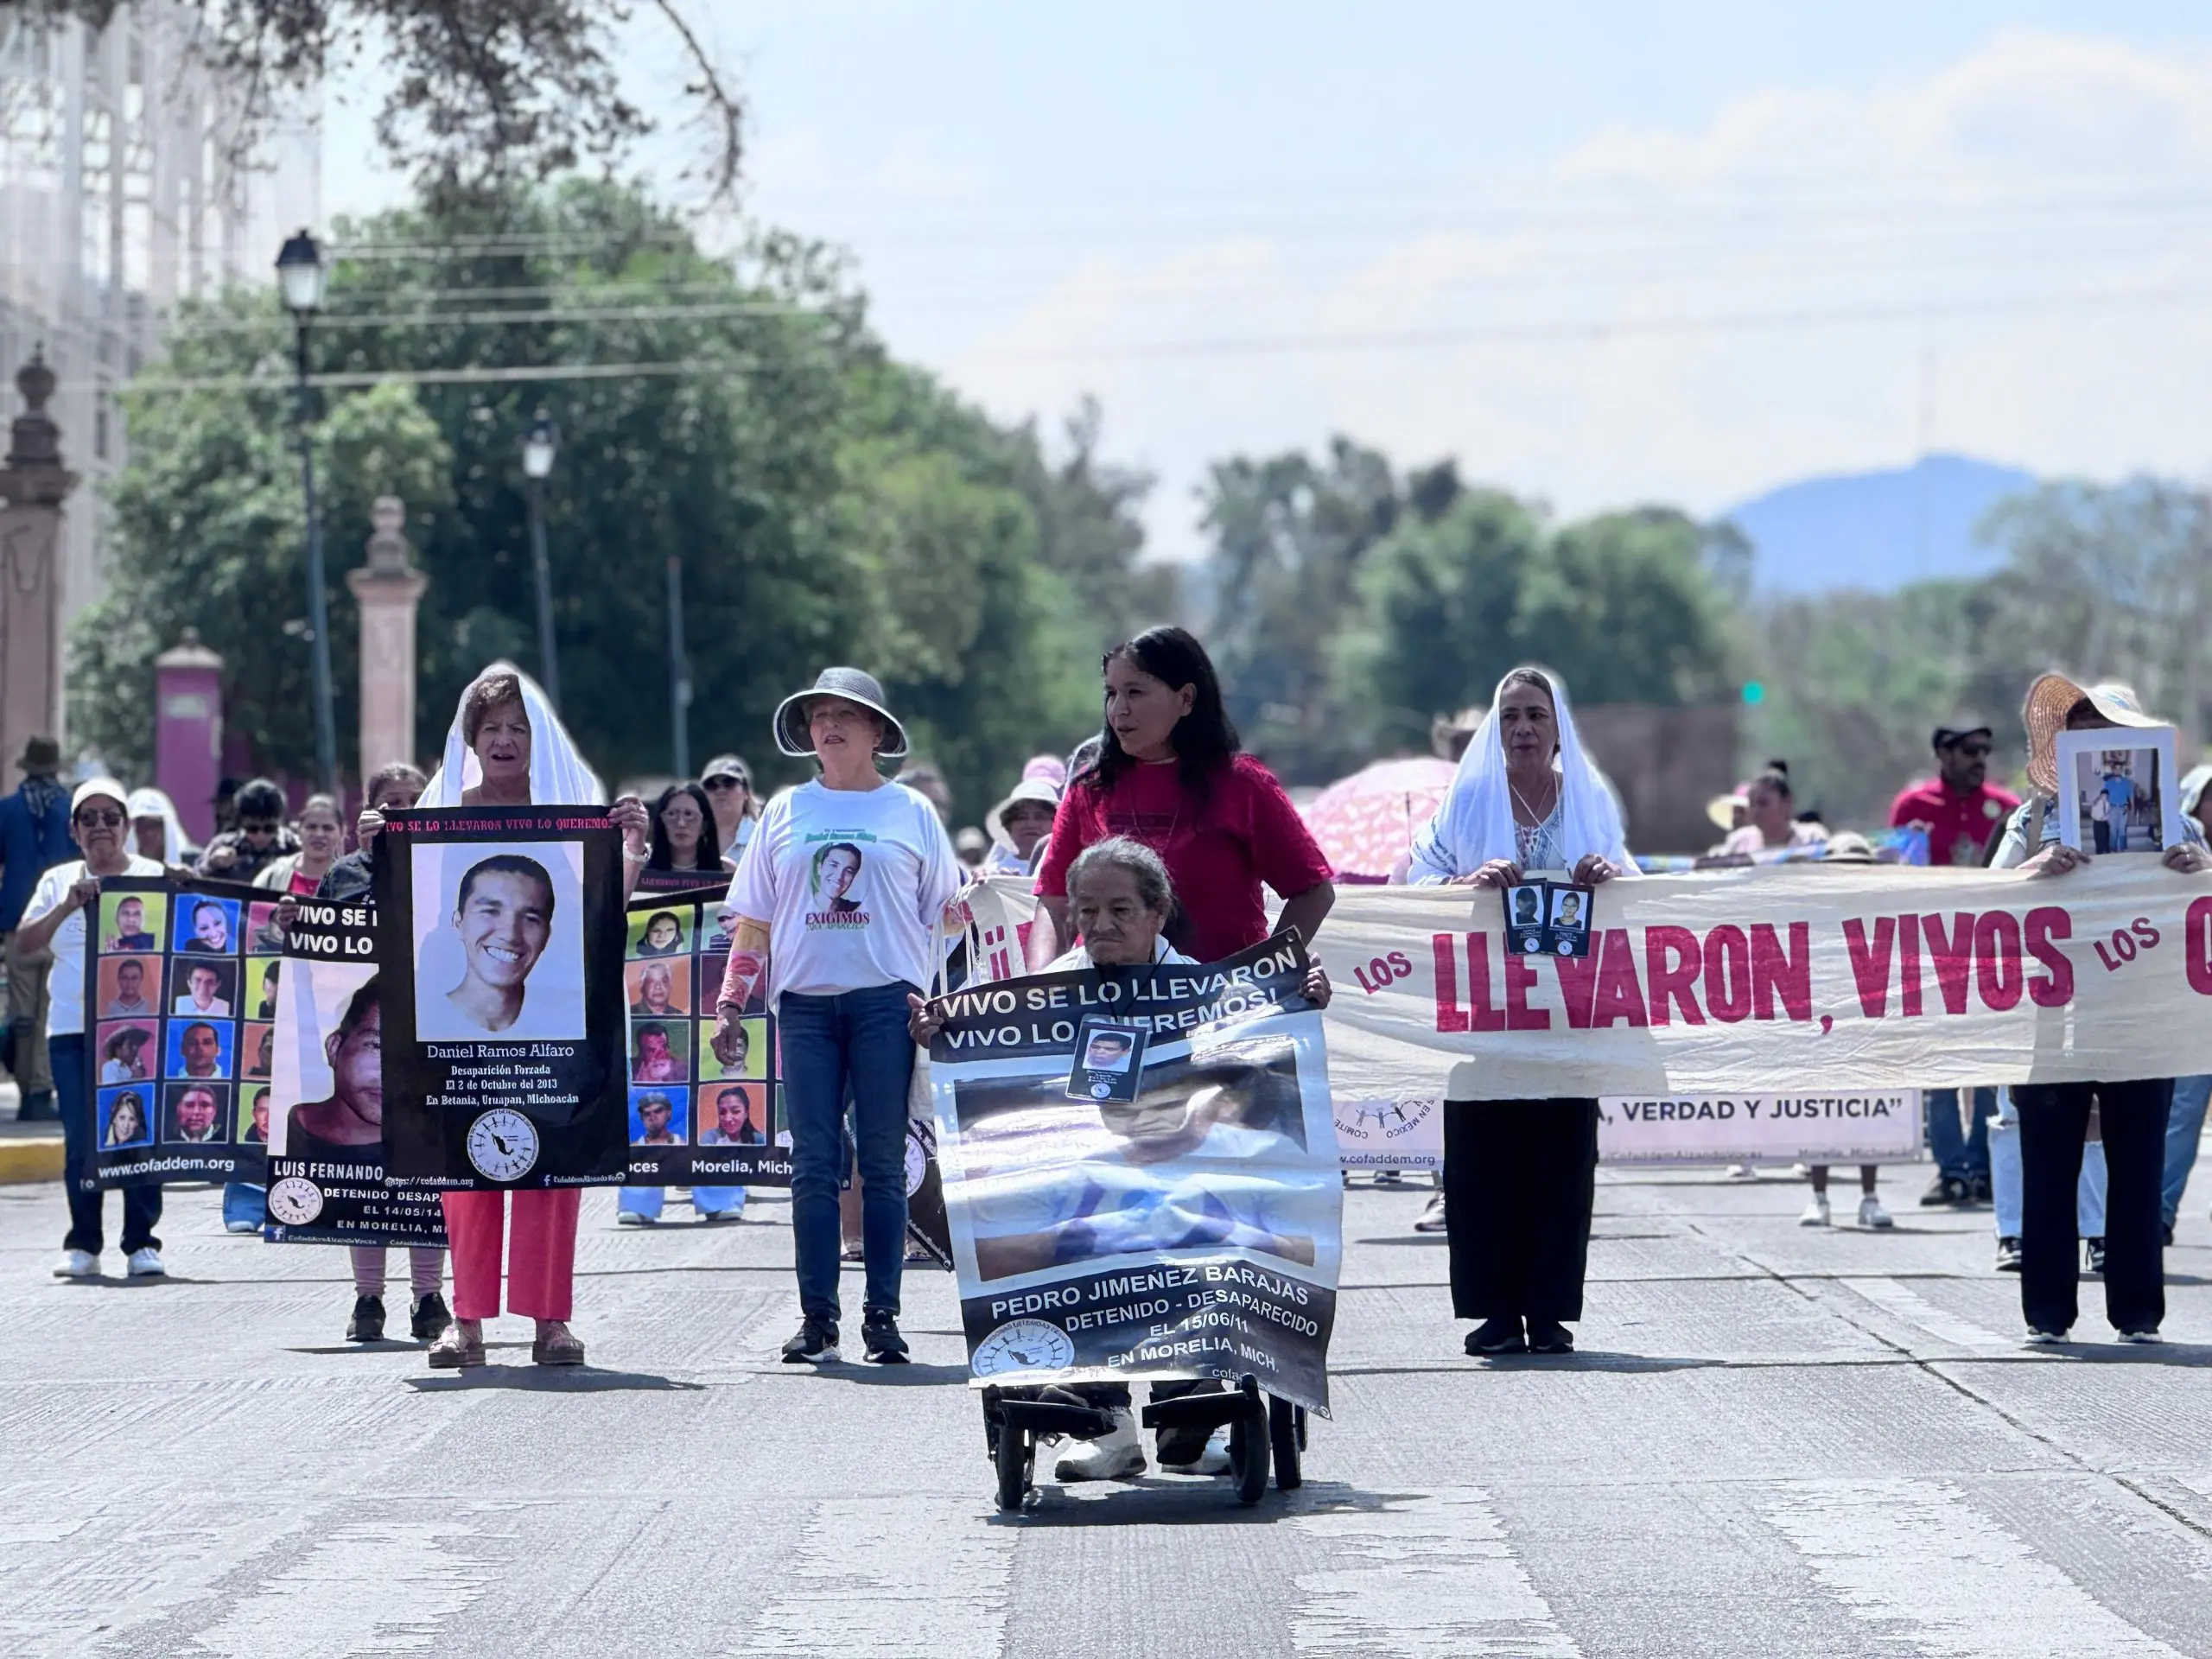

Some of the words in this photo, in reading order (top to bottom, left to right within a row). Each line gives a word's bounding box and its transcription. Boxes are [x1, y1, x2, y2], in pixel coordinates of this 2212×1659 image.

[385, 822, 404, 832] IVO
[407, 822, 422, 831] SE
[425, 821, 440, 831] LO
[444, 820, 502, 831] LLEVARON
[505, 819, 533, 830] VIVO
[537, 819, 551, 830] LO
[341, 908, 366, 926] SE
[804, 912, 870, 925] EXIGIMOS
[289, 931, 338, 953] VIVO
[345, 936, 373, 955] LO
[1026, 986, 1069, 1011] SE
[1078, 981, 1122, 1006] LO
[1132, 946, 1298, 1001] LLEVARON
[1353, 950, 1413, 995] LOS
[1432, 921, 1834, 1036] LLEVARON,
[1841, 906, 2075, 1019] VIVOS
[2092, 916, 2161, 973] LOS
[944, 1026, 1022, 1050] VIVO
[1032, 1020, 1075, 1045] LO
[427, 1045, 474, 1058] Daniel
[477, 1045, 526, 1058] Ramos
[529, 1042, 575, 1058] Alfaro
[451, 1065, 512, 1077] Desaparición
[514, 1065, 551, 1076] Forzada
[458, 1080, 464, 1090] 2
[467, 1079, 478, 1090] de
[481, 1079, 518, 1090] Octubre
[520, 1078, 534, 1090] del
[537, 1078, 557, 1089] 2013
[426, 1095, 439, 1106] En
[441, 1095, 480, 1107] Betania,
[481, 1095, 525, 1107] Uruapan,
[527, 1093, 580, 1104] Michoacán
[1621, 1100, 1736, 1122] VERDAD
[1744, 1099, 1763, 1119] Y
[98, 1156, 235, 1179] www.cofaddem.org
[274, 1160, 306, 1178] LUIS
[309, 1162, 384, 1181] FERNANDO
[691, 1160, 753, 1174] Morelia,
[323, 1187, 390, 1200] DETENIDO
[397, 1192, 443, 1203] DESAP
[363, 1205, 379, 1215] EL
[336, 1219, 355, 1229] EN
[359, 1221, 429, 1235] MORELIA,
[991, 1287, 1080, 1319] PEDRO
[1205, 1265, 1309, 1306] BARAJAS
[1065, 1299, 1170, 1332] DETENIDO
[1187, 1288, 1319, 1338] DESAPARECIDO
[1149, 1323, 1176, 1338] EL
[1179, 1312, 1249, 1334] 15/06/11
[1107, 1351, 1135, 1369] EN
[1140, 1337, 1237, 1362] MORELIA,
[1240, 1343, 1281, 1374] MICH.
